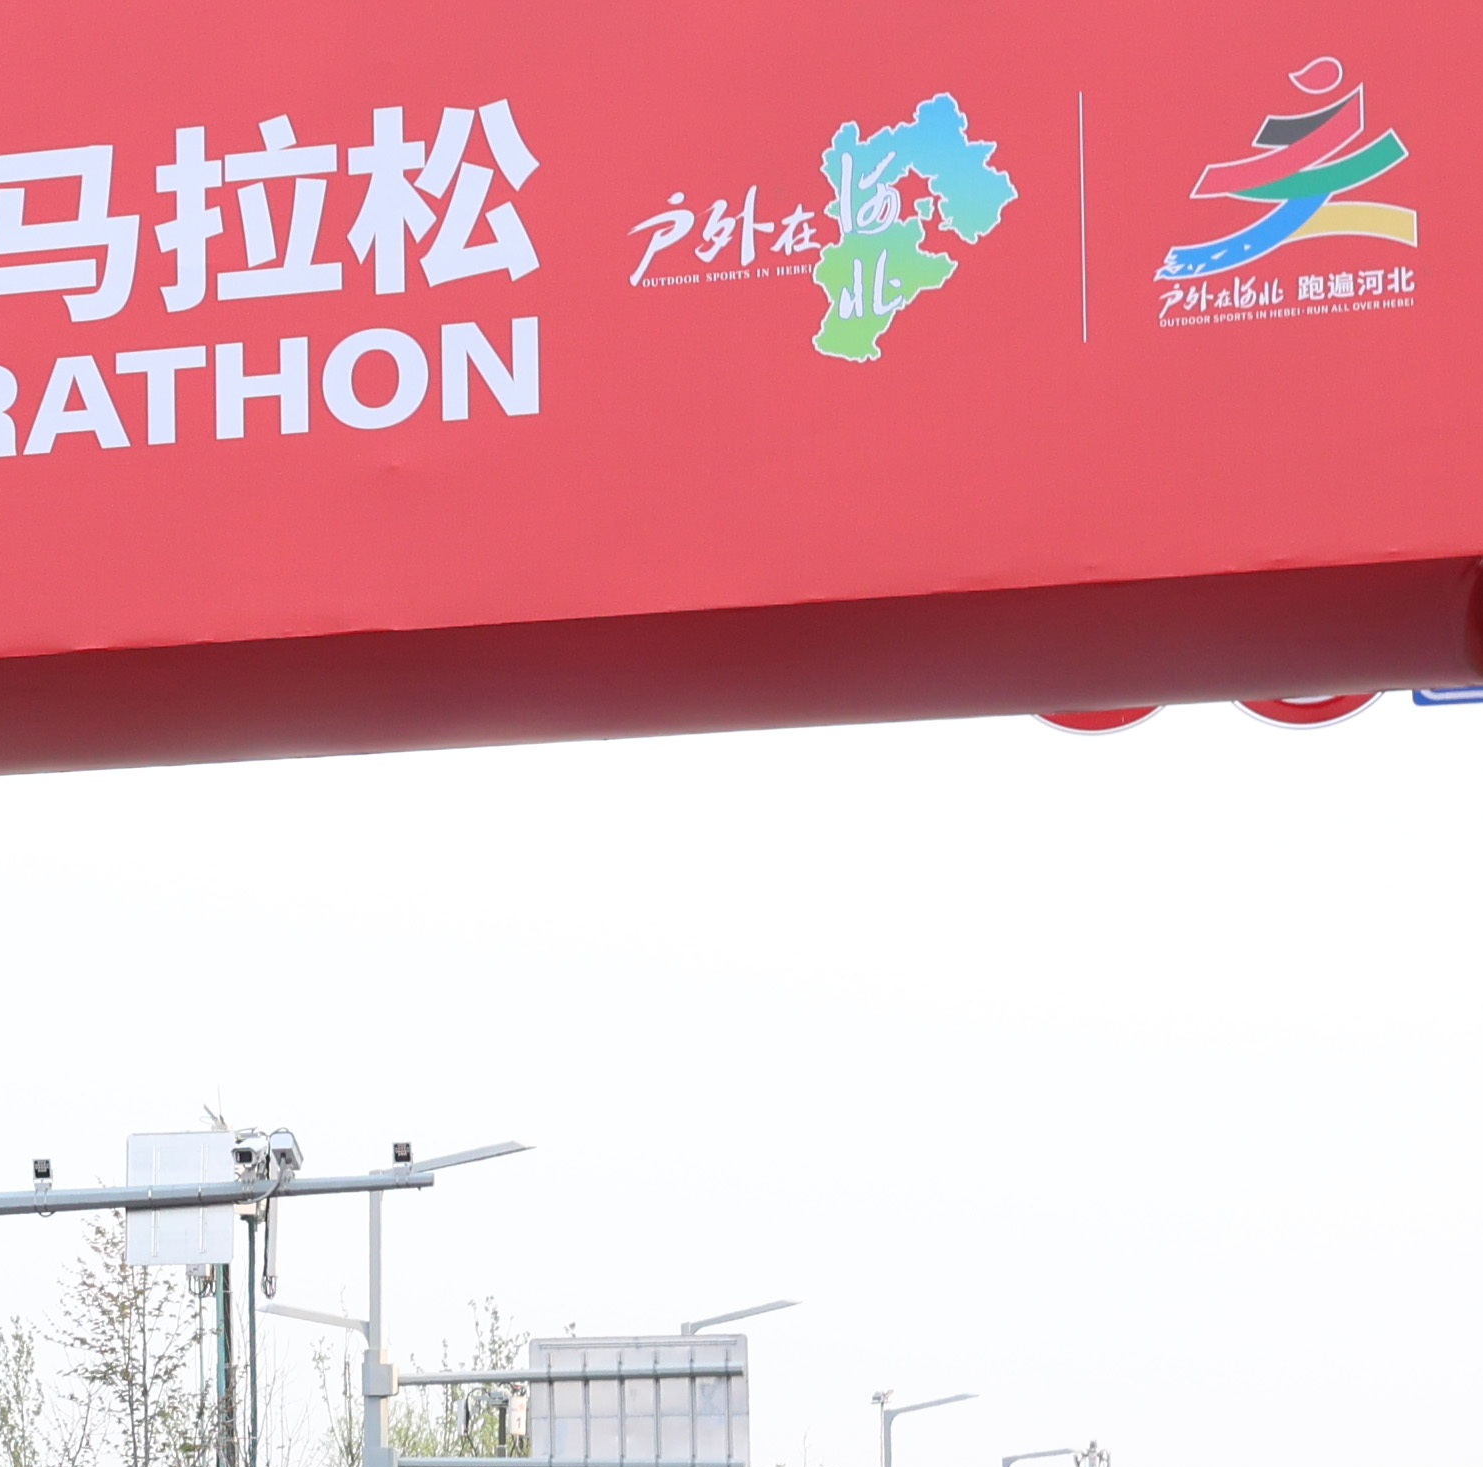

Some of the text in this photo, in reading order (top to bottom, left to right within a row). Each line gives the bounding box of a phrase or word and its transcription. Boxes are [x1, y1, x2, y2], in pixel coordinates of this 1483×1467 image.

[641, 263, 814, 288] OUTDOOR SPORTS IN HEBEI
[1297, 265, 1416, 301] 跑遍河北
[1159, 314, 1211, 328] OUTDOOR
[1213, 311, 1254, 324] SPORTS
[1256, 309, 1267, 320] IN
[1331, 302, 1350, 313] ALL
[1352, 300, 1380, 311] OVER
[1382, 296, 1415, 308] HEBEI
